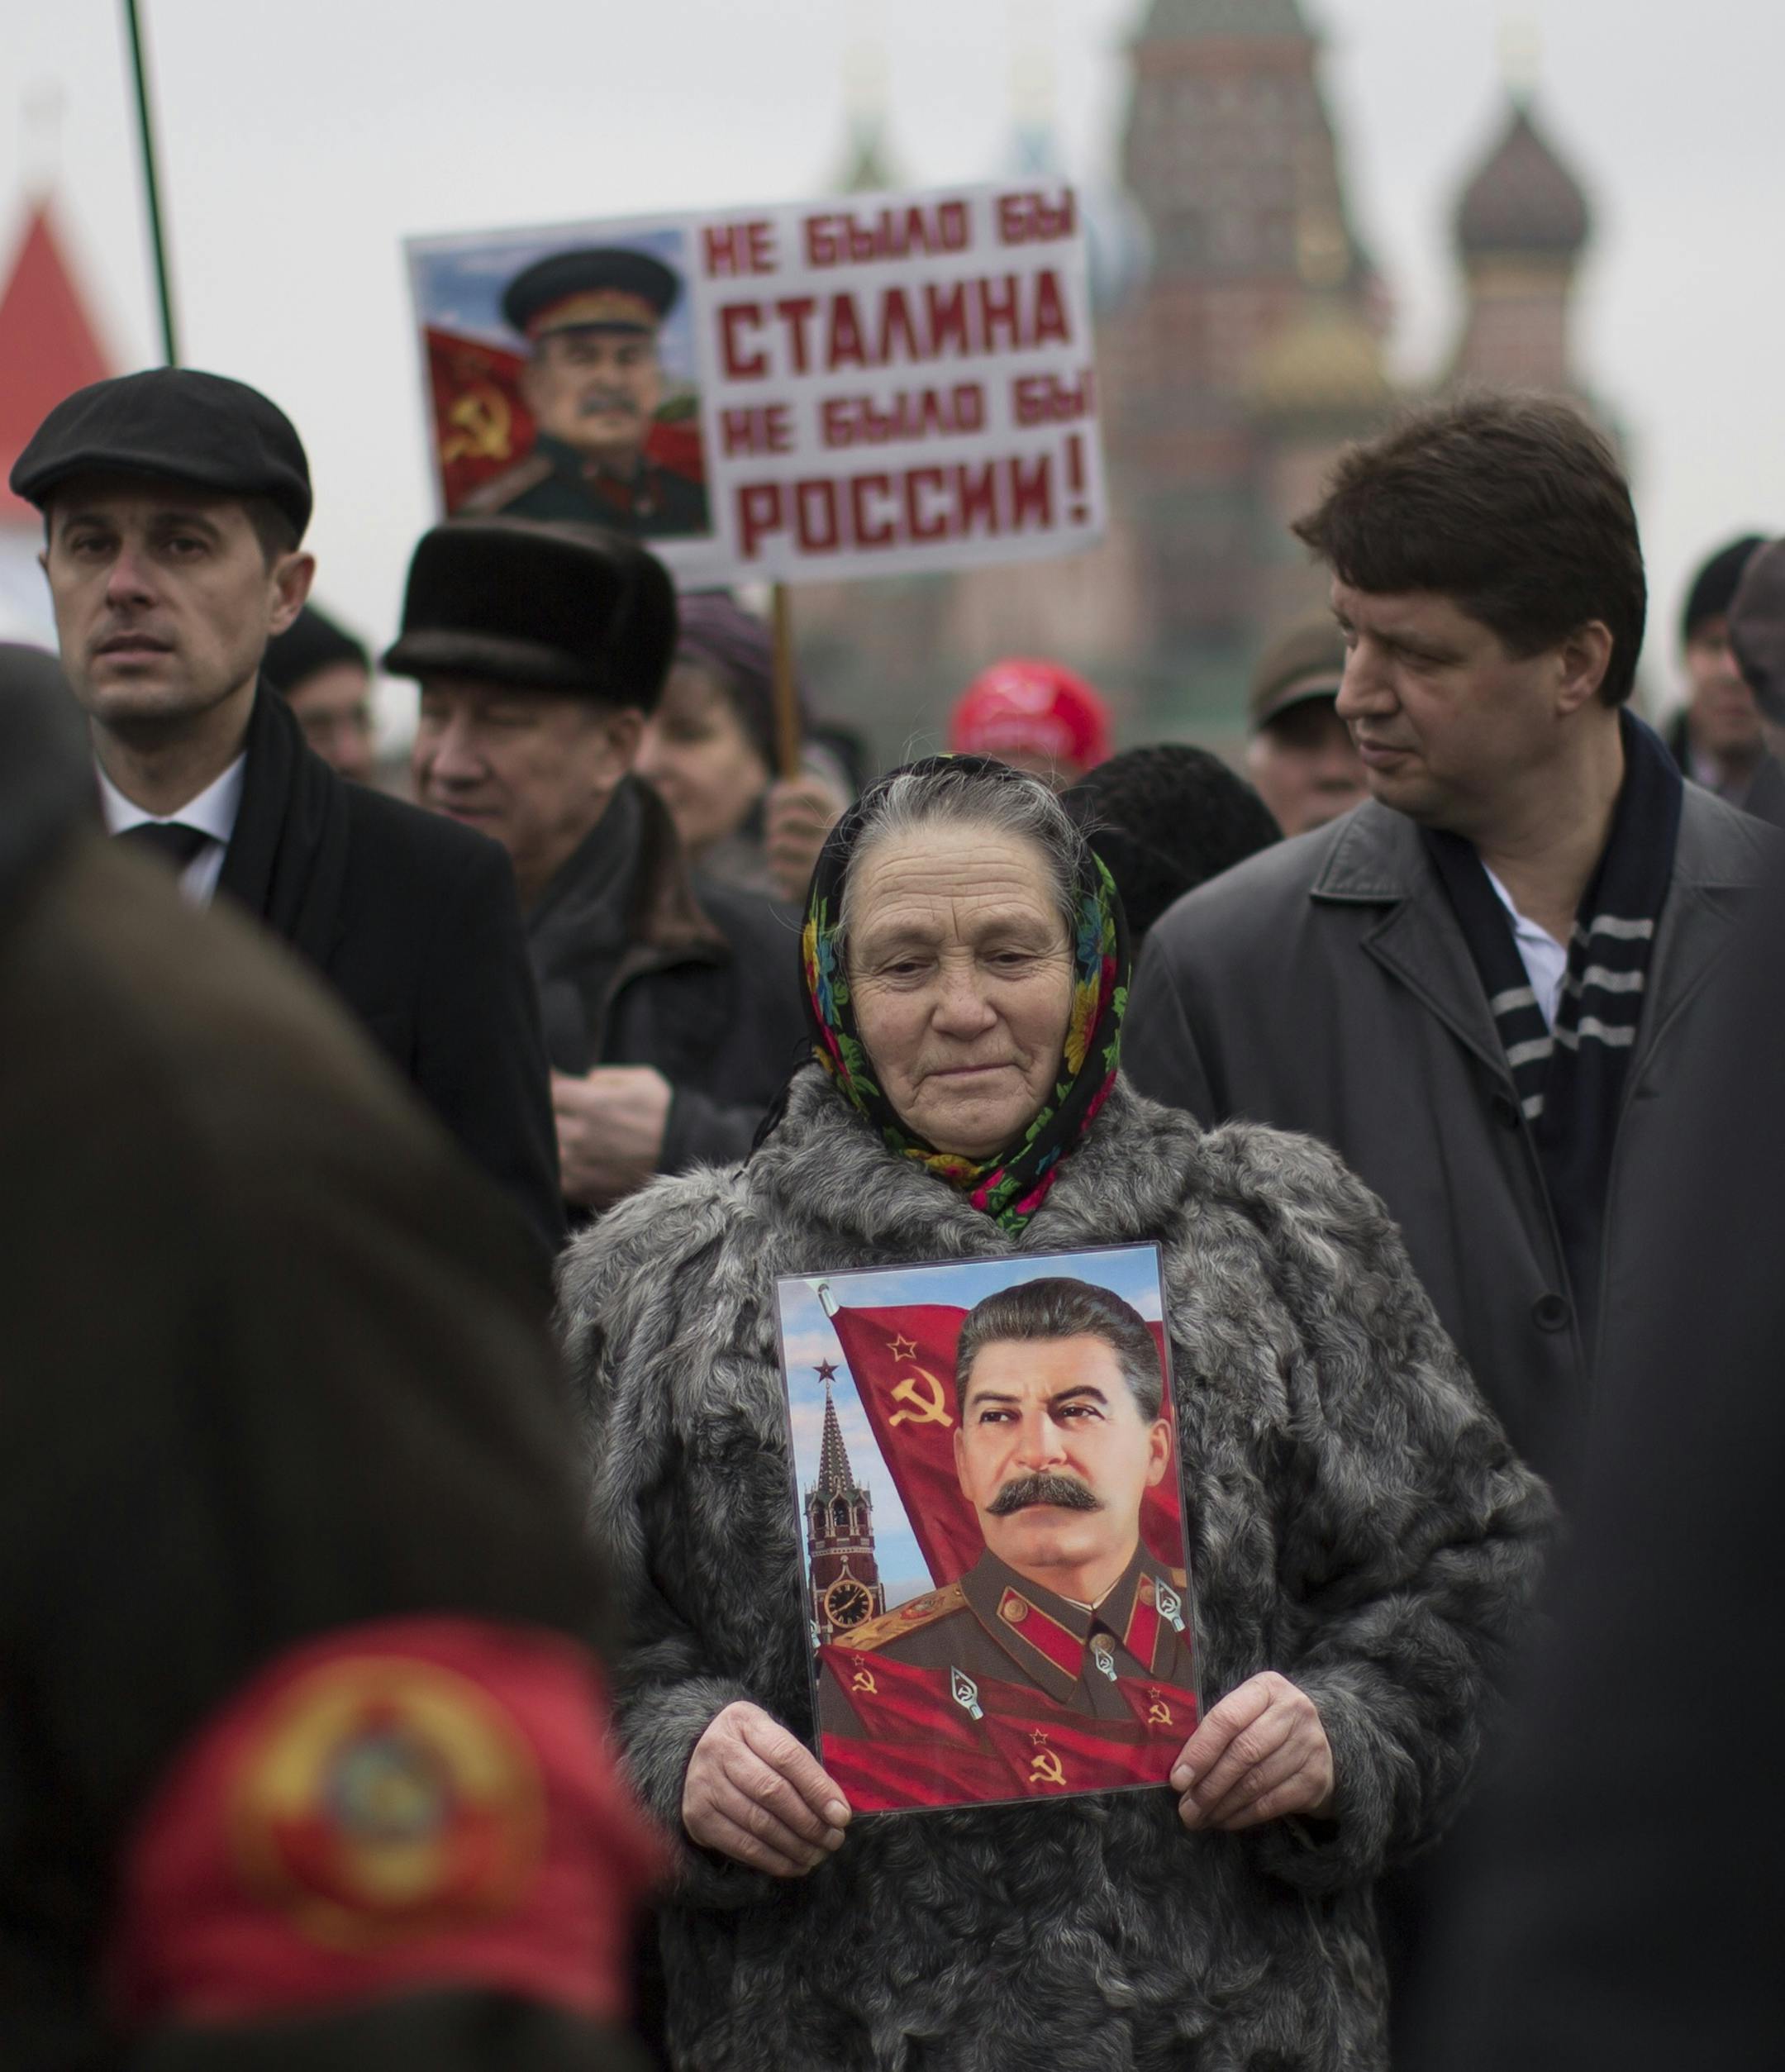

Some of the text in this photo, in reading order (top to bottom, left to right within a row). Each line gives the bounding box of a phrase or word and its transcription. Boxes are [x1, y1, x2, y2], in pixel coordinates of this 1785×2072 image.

[702, 186, 1075, 279] НЕ БЫЛО БЫ
[717, 269, 1070, 381] СТАЛИНА
[720, 369, 1096, 460] НЕ БЫЛО БЫ
[737, 432, 1088, 562] РОССИИ!
